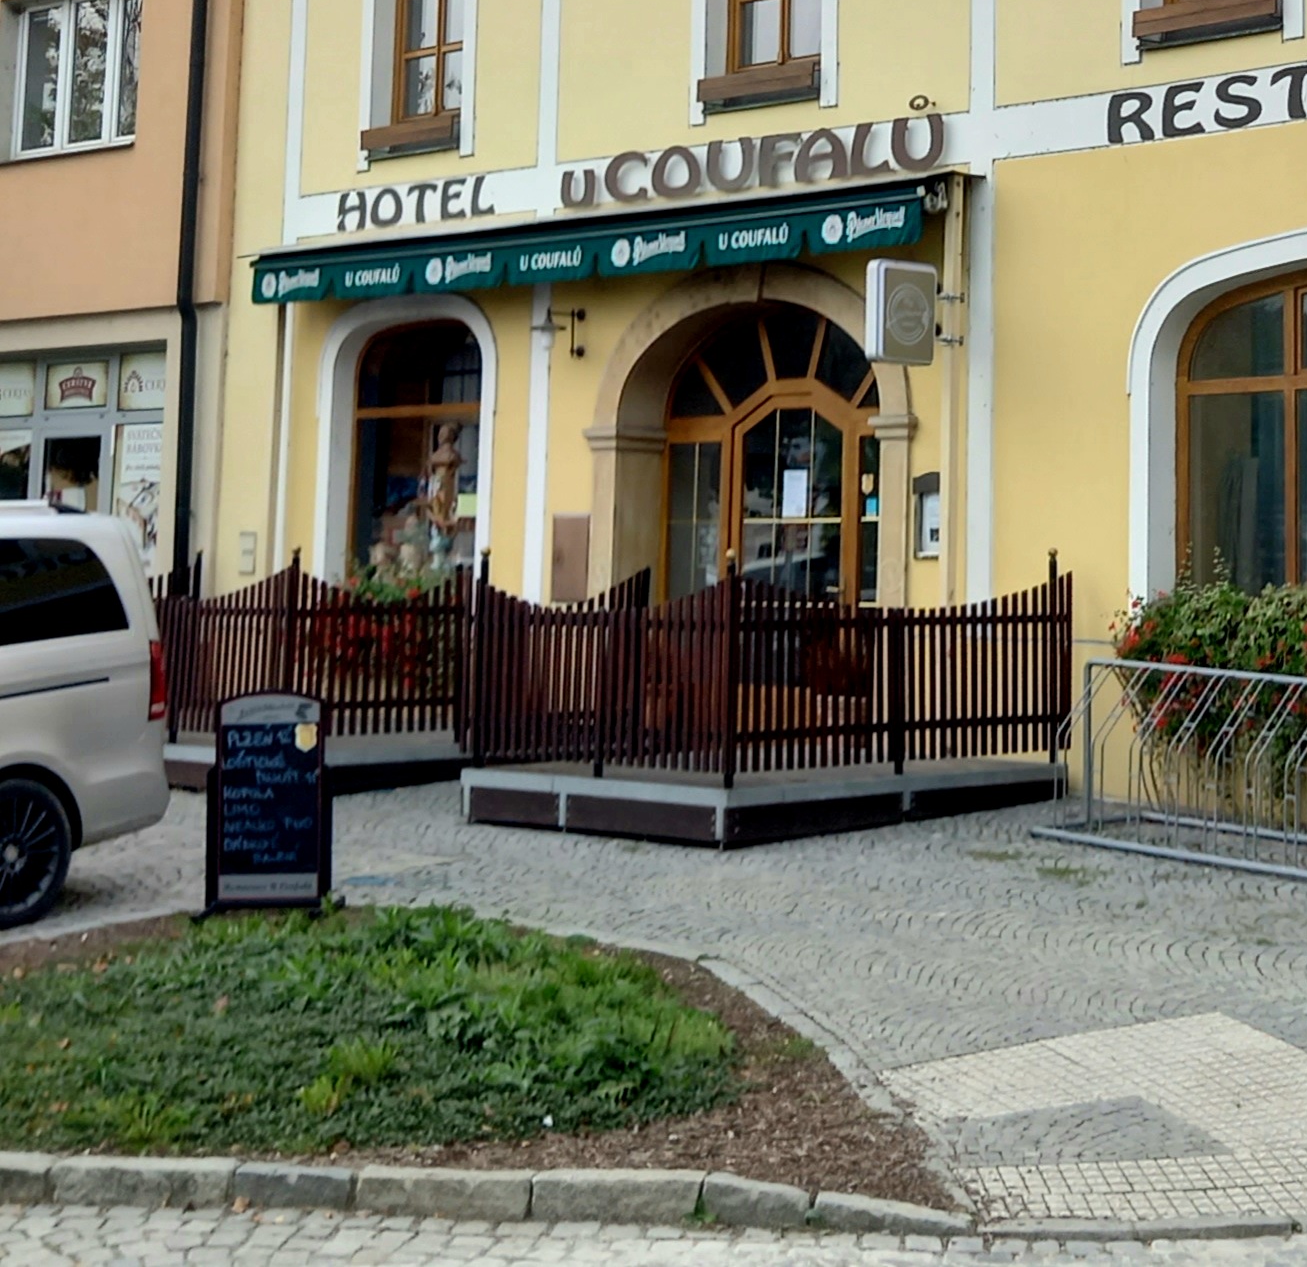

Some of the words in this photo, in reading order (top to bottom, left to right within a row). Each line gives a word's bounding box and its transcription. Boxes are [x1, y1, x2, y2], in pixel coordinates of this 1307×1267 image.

[604, 94, 945, 204] COUFALŮ
[336, 174, 496, 233] HOTEL
[718, 233, 729, 251] U
[519, 254, 529, 272] U
[345, 270, 354, 287] U
